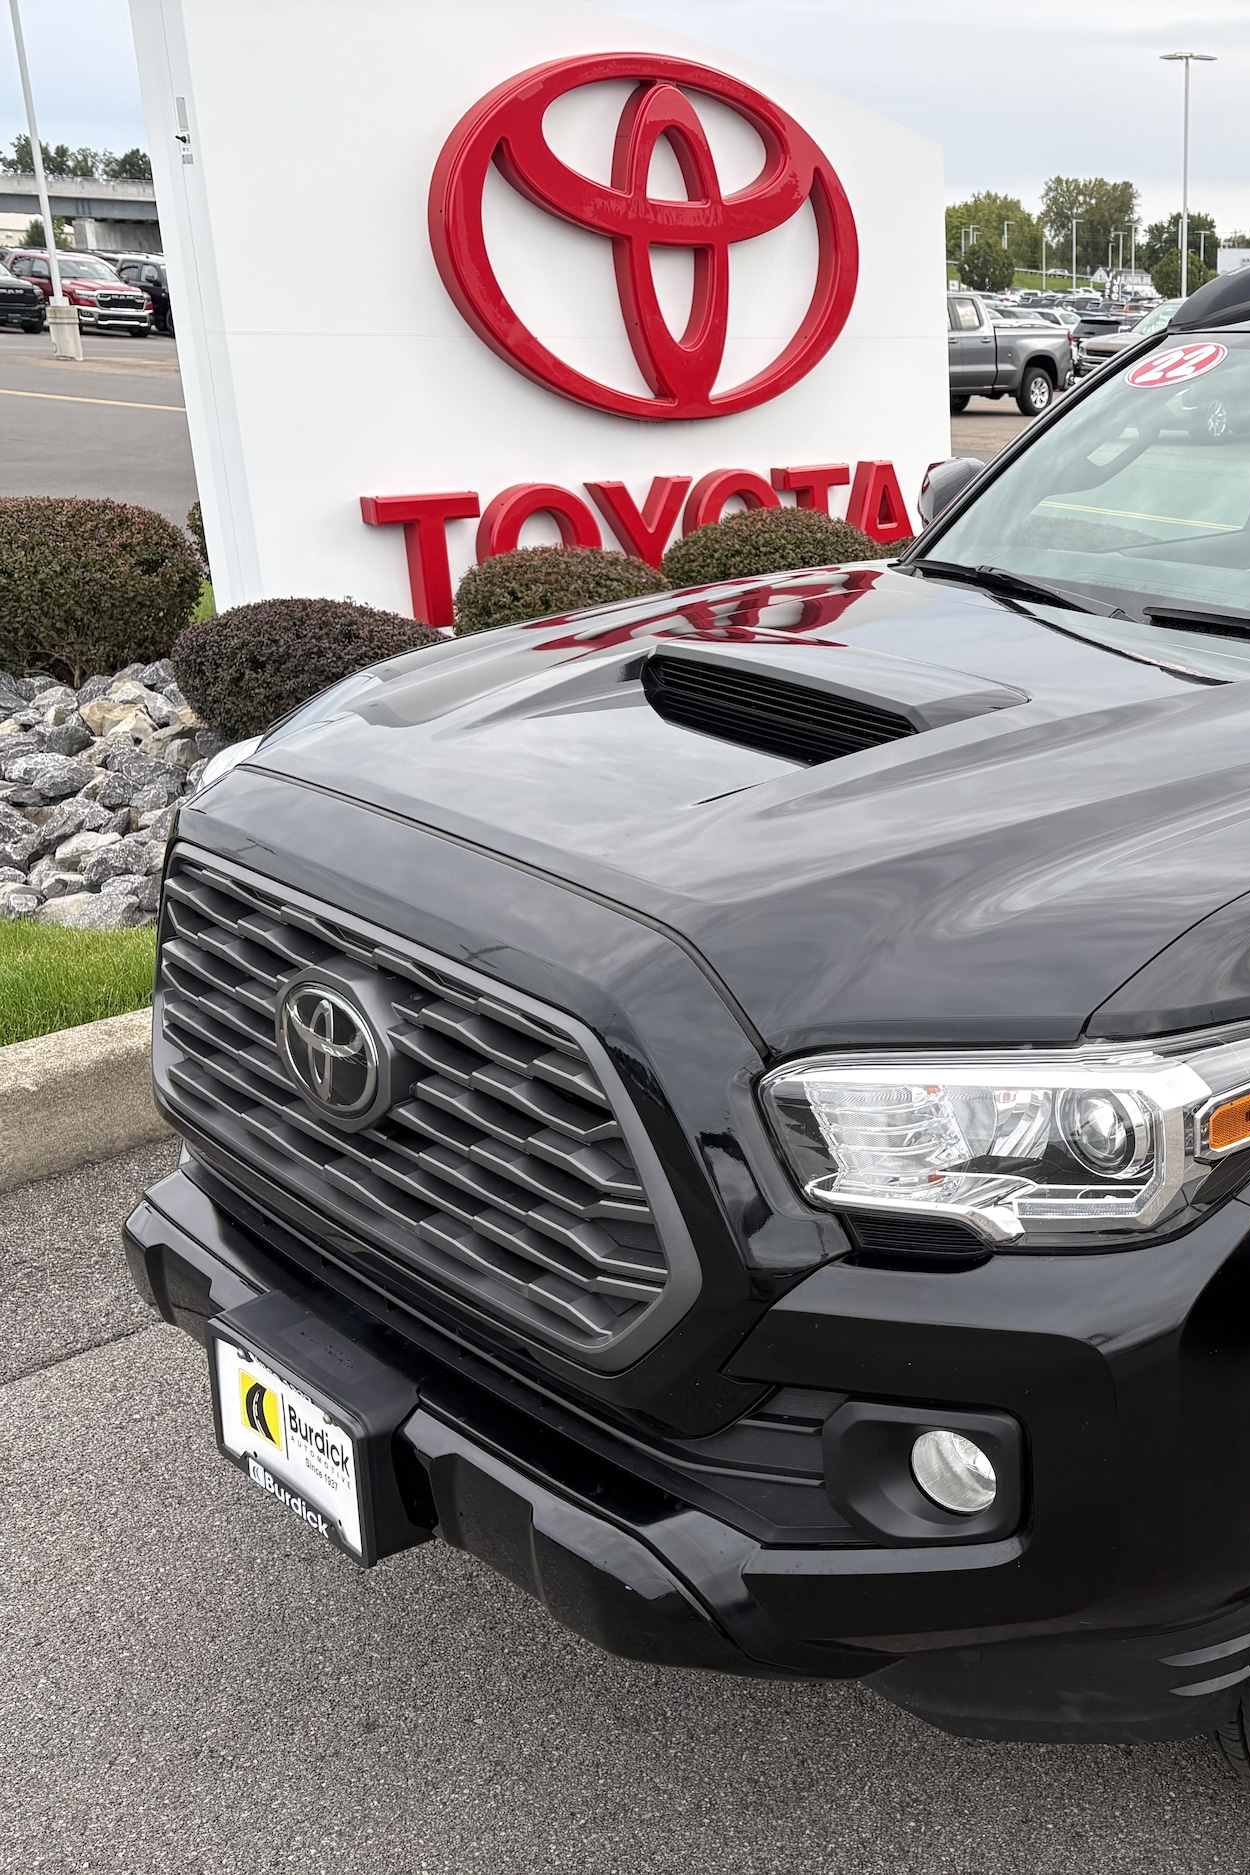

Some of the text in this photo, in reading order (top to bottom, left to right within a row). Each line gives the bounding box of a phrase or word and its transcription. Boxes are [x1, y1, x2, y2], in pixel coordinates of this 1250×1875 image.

[1111, 275, 1120, 301] Jee
[1134, 345, 1217, 384] 22
[288, 1404, 350, 1478] Burdick
[291, 1436, 351, 1489] AUTOMOTIVE
[305, 1458, 339, 1492] Since 1937
[265, 1472, 329, 1539] Burdick
